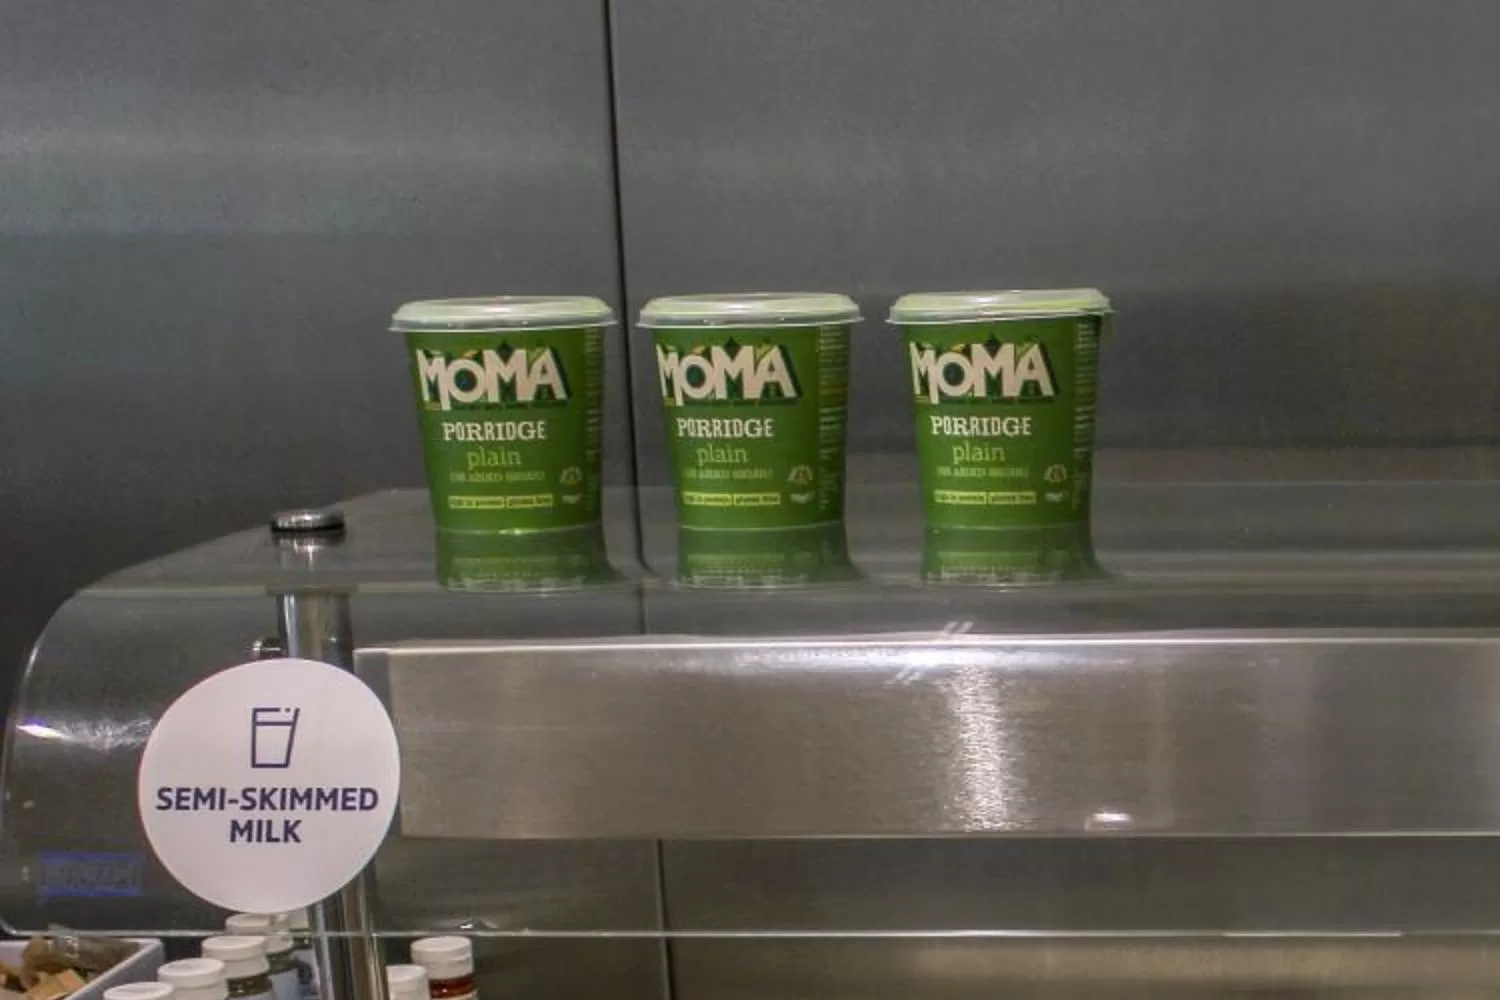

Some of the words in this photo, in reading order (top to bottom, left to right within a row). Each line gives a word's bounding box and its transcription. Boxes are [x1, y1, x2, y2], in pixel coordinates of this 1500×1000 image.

[416, 347, 569, 411] MOMA
[656, 343, 797, 407] MOMA
[909, 341, 1055, 405] MOMA
[442, 421, 547, 441] PORRIDGE
[676, 418, 774, 438] PORRIDGE
[930, 415, 1032, 436] PORRIDGE
[467, 447, 522, 470] plain
[696, 444, 749, 465] plain
[953, 441, 1006, 464] plain
[156, 787, 380, 811] SEMI-SKIMMED
[229, 820, 302, 843] MILK
